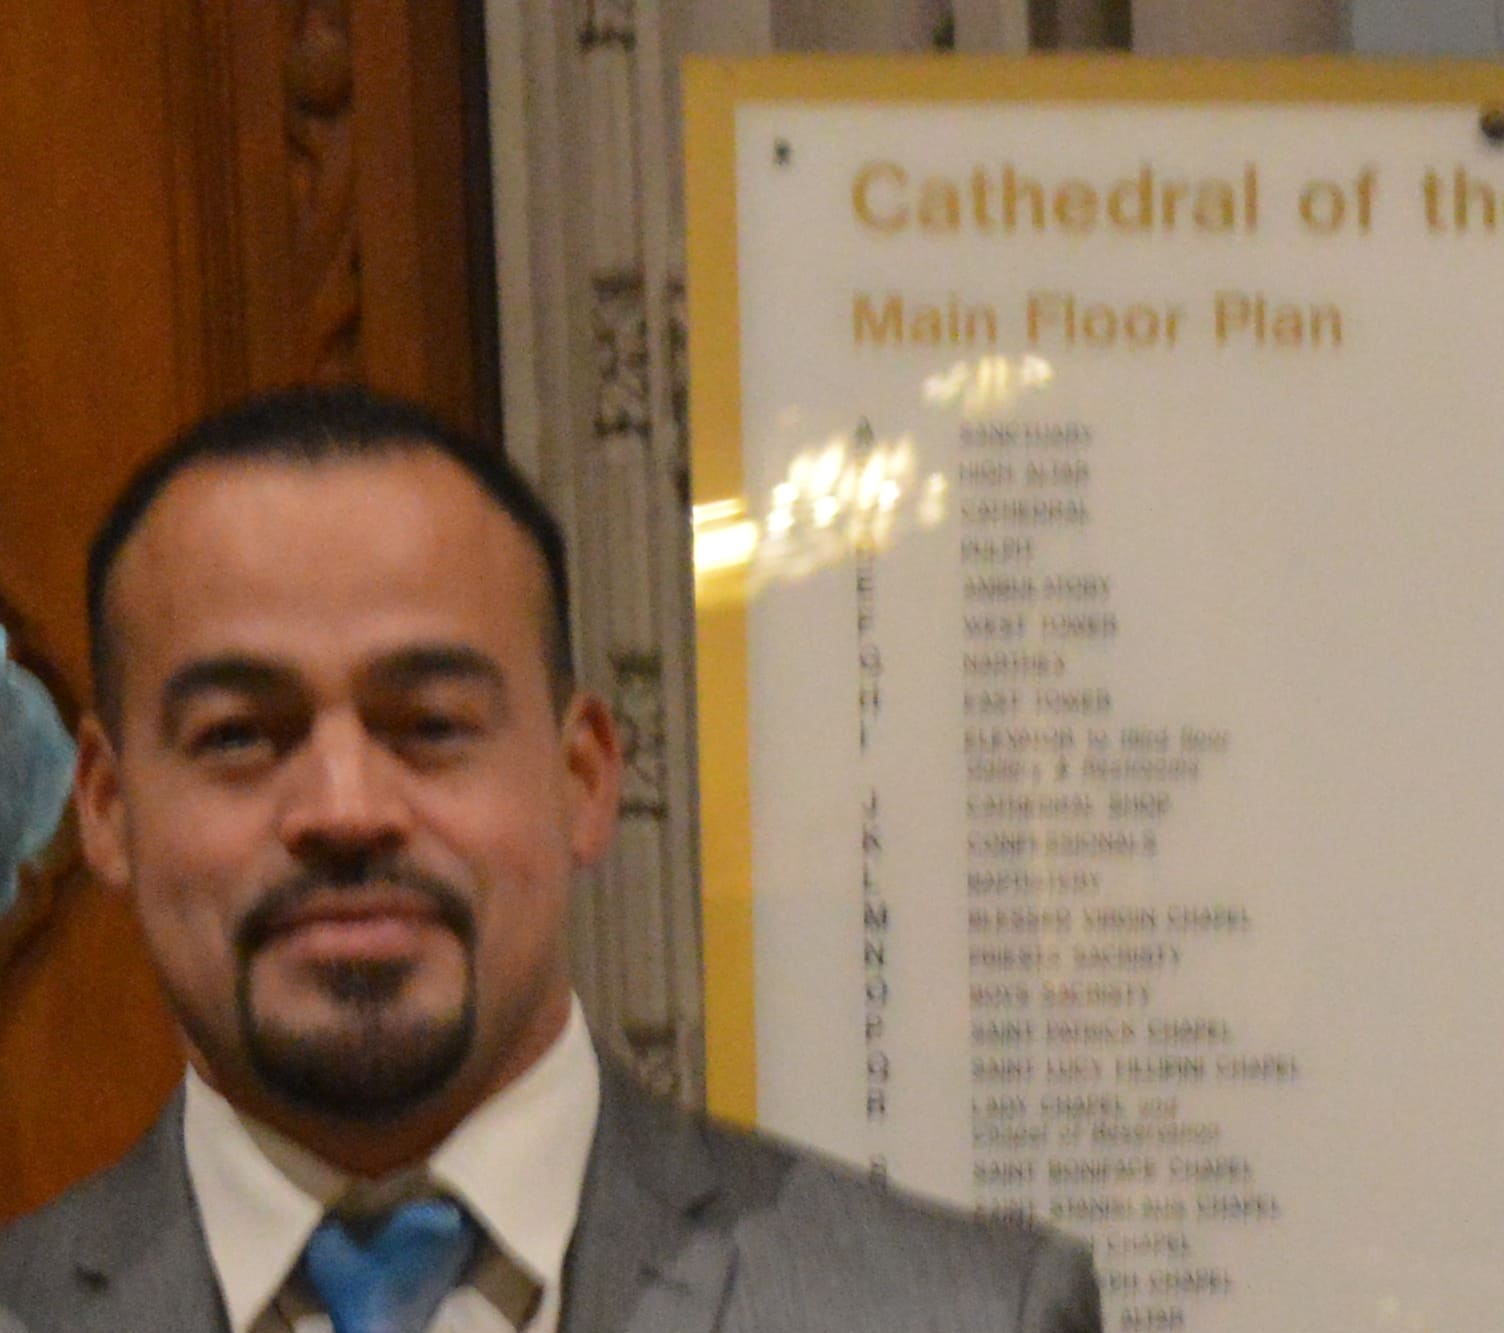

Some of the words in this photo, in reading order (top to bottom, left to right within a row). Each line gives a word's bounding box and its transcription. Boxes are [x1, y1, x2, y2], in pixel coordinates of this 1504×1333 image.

[850, 159, 1260, 238] Cathedral
[1296, 160, 1378, 238] of
[851, 288, 999, 348] Main
[1024, 288, 1183, 348] Floor
[1211, 288, 1344, 350] Plan
